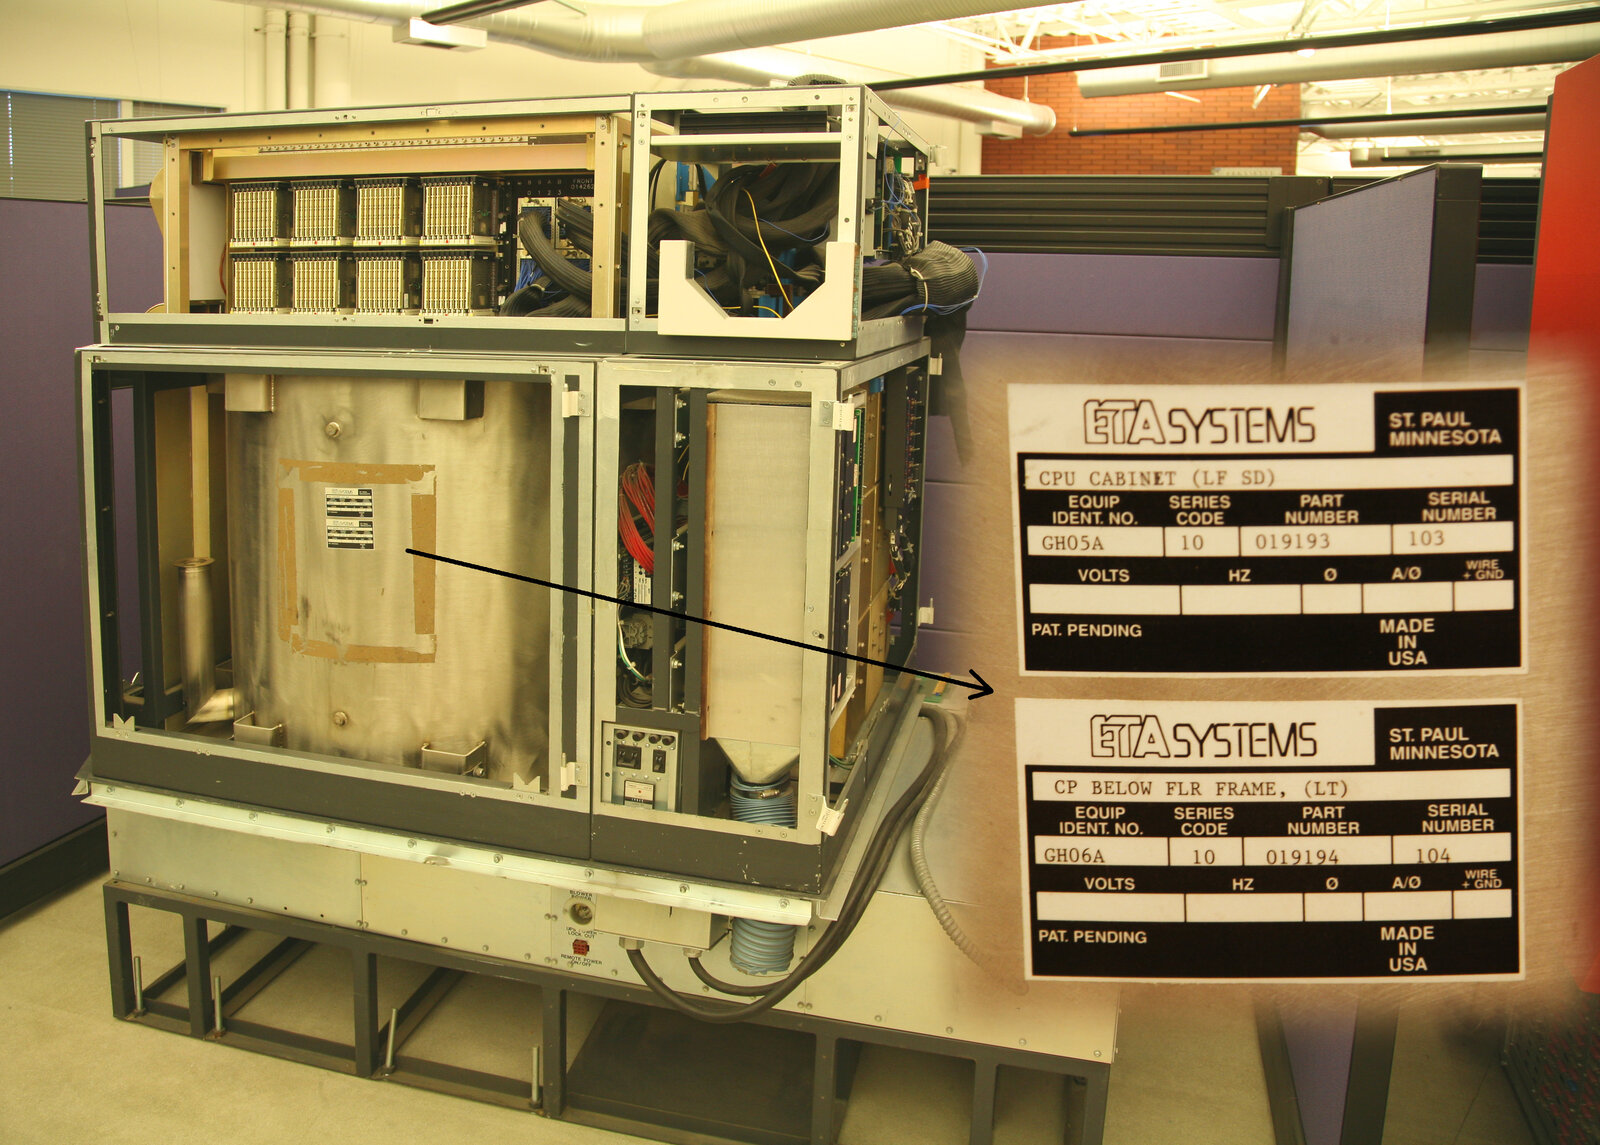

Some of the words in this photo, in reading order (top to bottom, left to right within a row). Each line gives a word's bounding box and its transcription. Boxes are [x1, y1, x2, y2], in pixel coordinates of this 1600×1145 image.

[1084, 399, 1166, 445] ETA
[1168, 407, 1315, 444] SYSTEMS
[1390, 413, 1415, 428] ST.
[1422, 412, 1471, 427] PAUL
[1390, 429, 1501, 446] MINNESOTA
[1039, 471, 1074, 486] CPU
[1090, 471, 1176, 486] CABINET
[1193, 470, 1227, 488] (LF
[1242, 469, 1274, 487] SD)
[1069, 495, 1119, 508] EQUIP
[1170, 495, 1230, 509] SERIES
[1301, 494, 1343, 507] PART
[1429, 491, 1490, 505] SERIAL
[1053, 511, 1103, 524] IDENT.
[1109, 512, 1137, 525] NO.
[1176, 512, 1224, 525] CODE
[1286, 511, 1358, 524] NUMBER
[1423, 507, 1498, 522] NUMBER
[1042, 535, 1104, 550] GH05A
[1183, 535, 1203, 550] 10
[1256, 533, 1329, 549] 019193
[1411, 530, 1444, 546] 103
[1466, 559, 1498, 569] WIRE
[1078, 569, 1129, 582] VOLTS
[1229, 569, 1250, 582] HZ
[1476, 569, 1504, 580] GND
[1032, 623, 1061, 636] PAT.
[1068, 624, 1142, 637] PENDING
[1380, 618, 1434, 633] MADE
[1399, 635, 1416, 649] IN
[1389, 651, 1427, 665] USA
[1090, 715, 1171, 758] ETA
[1173, 722, 1317, 758] SYSTEMS
[1390, 728, 1414, 742] ST.
[1421, 727, 1469, 741] PAUL
[1390, 744, 1499, 760] MINNESOTA
[1055, 780, 1077, 794] CP
[1092, 781, 1152, 795] BELOW
[1166, 782, 1202, 795] FLR
[1216, 782, 1285, 798] FRAME,
[1305, 780, 1347, 798] (LT)
[1076, 806, 1125, 819] EQUIP
[1175, 807, 1234, 819] SERIES
[1303, 806, 1345, 818] PART
[1428, 804, 1488, 817] SERIAL
[1060, 822, 1109, 834] IDENT.
[1115, 822, 1143, 835] NO.
[1181, 823, 1228, 835] CODE
[1288, 822, 1359, 835] NUMBER
[1423, 819, 1494, 832] NUMBER
[1045, 848, 1104, 863] GH06A
[1194, 850, 1215, 864] 10
[1267, 850, 1342, 865] 019194
[1418, 848, 1450, 862] 104
[1465, 869, 1496, 879] WIRE
[1085, 877, 1135, 890] VOLTS
[1233, 878, 1254, 890] HZ
[1475, 879, 1502, 889] GND
[1039, 930, 1068, 942] PAT.
[1074, 931, 1147, 943] PENDING
[1381, 926, 1434, 940] MADE
[1399, 942, 1416, 955] IN
[1390, 957, 1427, 971] USA
